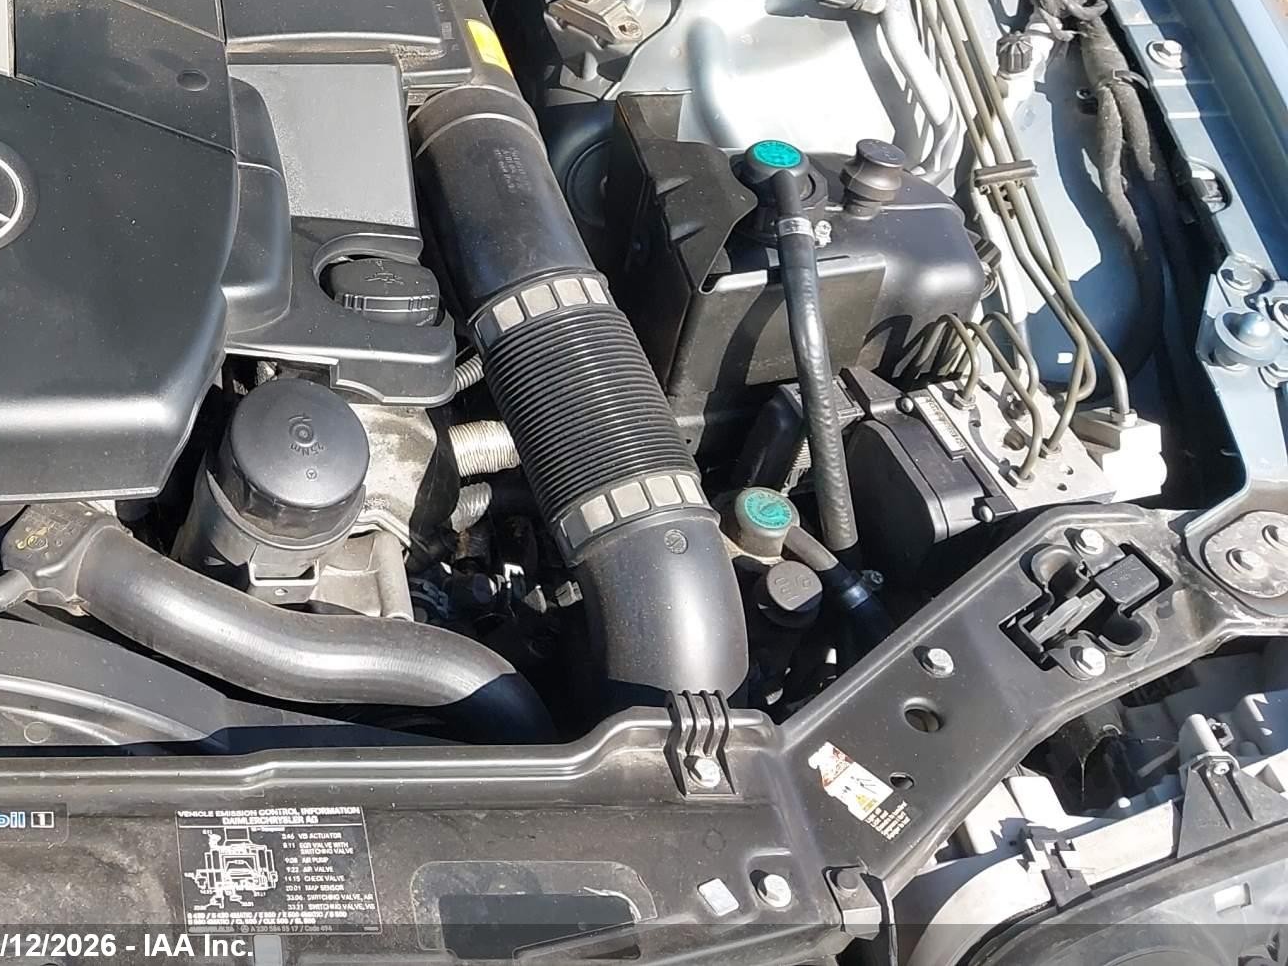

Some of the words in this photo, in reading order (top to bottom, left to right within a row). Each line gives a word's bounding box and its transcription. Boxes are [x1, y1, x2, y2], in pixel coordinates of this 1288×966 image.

[215, 809, 257, 817] EMISSION
[259, 808, 300, 816] CONTROL
[301, 807, 360, 815] INFORMATION
[222, 816, 304, 825] DAIMLERCHRYSLER
[306, 816, 318, 824] AG
